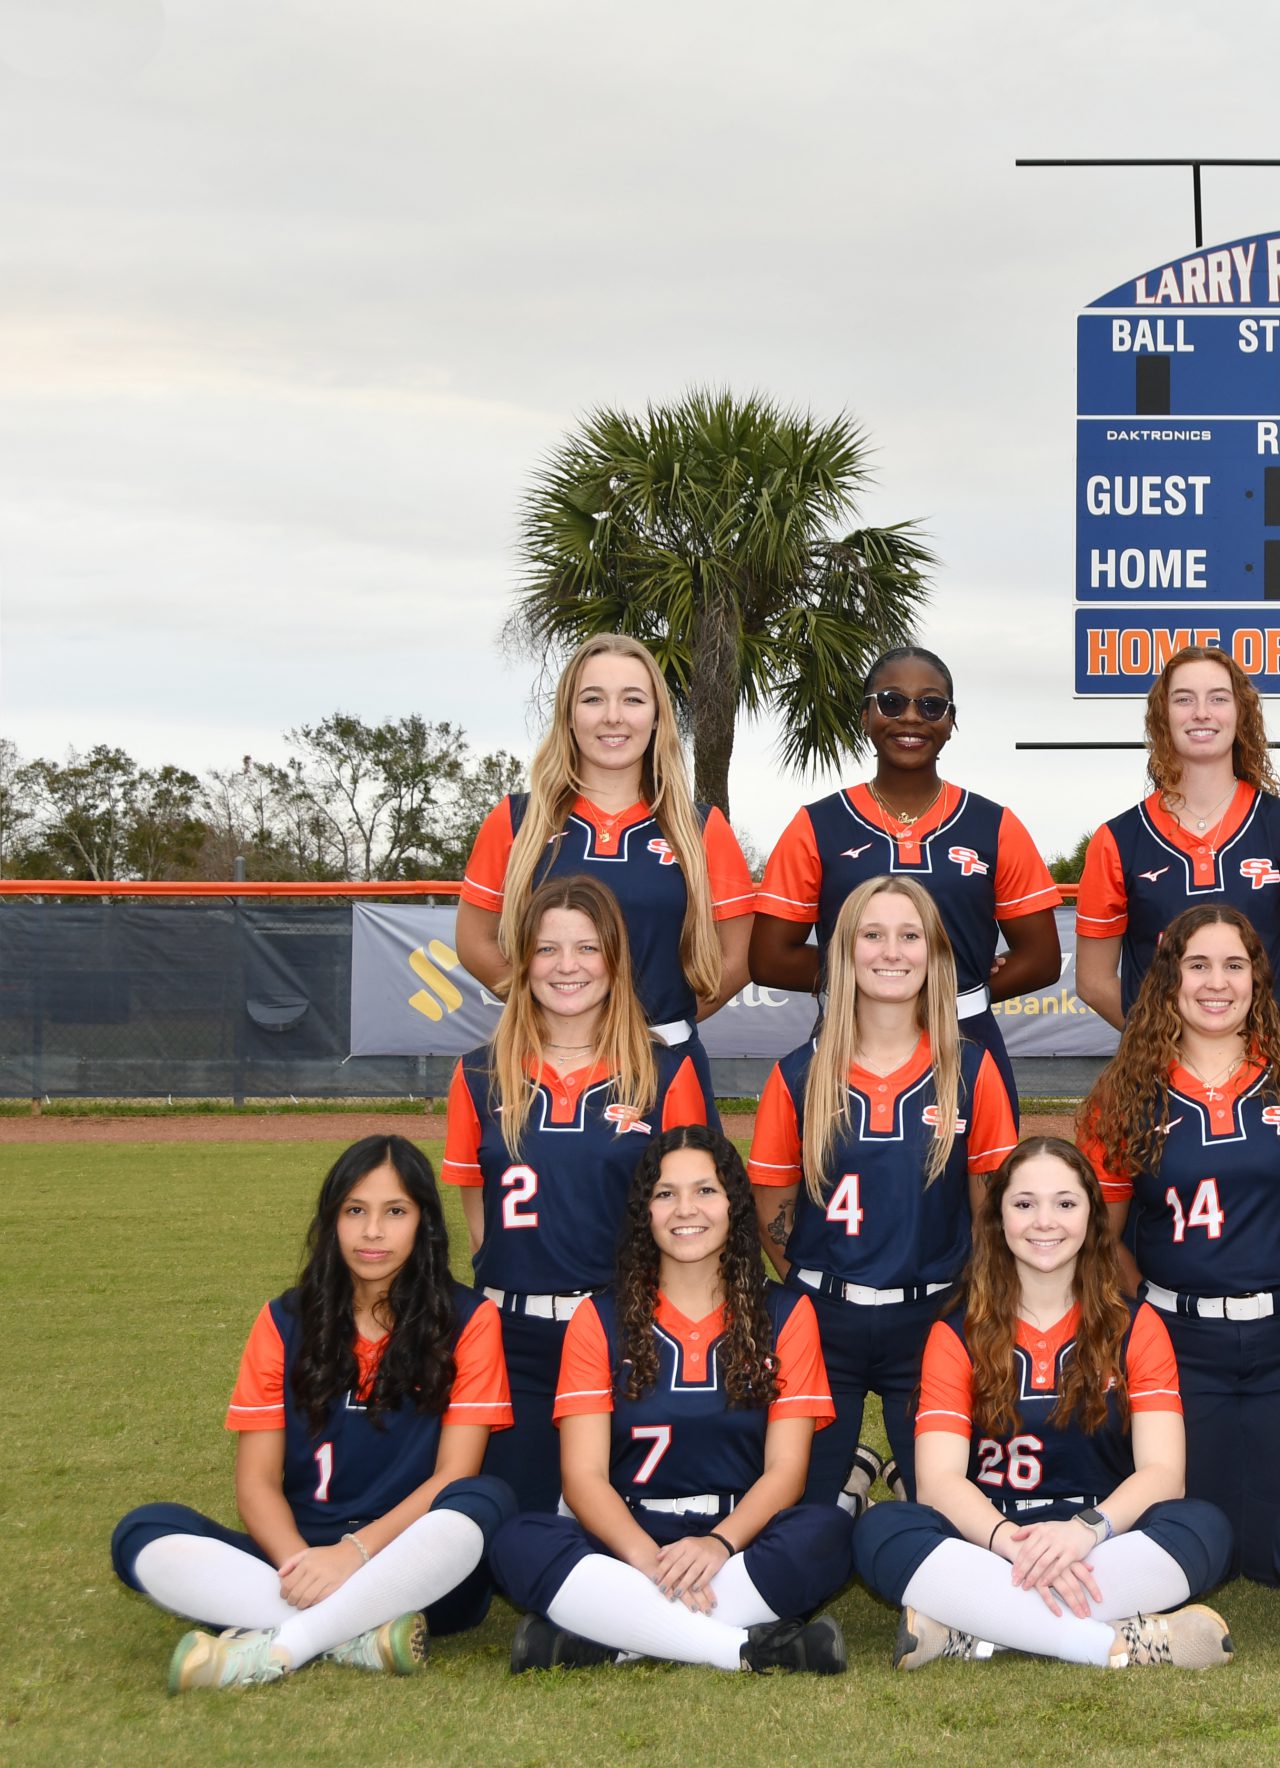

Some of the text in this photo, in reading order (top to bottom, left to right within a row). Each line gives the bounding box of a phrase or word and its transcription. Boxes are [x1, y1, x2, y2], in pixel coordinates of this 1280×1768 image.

[1135, 242, 1257, 304] LARRY
[1112, 320, 1195, 352] BALL
[1107, 431, 1212, 442] DAKTRONICS
[1086, 476, 1212, 517] GUEST
[1090, 549, 1207, 590] HOME
[501, 1164, 539, 1230] 2
[826, 1173, 864, 1236] 4
[1165, 1178, 1225, 1243] 14
[313, 1442, 335, 1502] 1
[631, 1425, 672, 1484] 7
[977, 1434, 1044, 1491] 26
